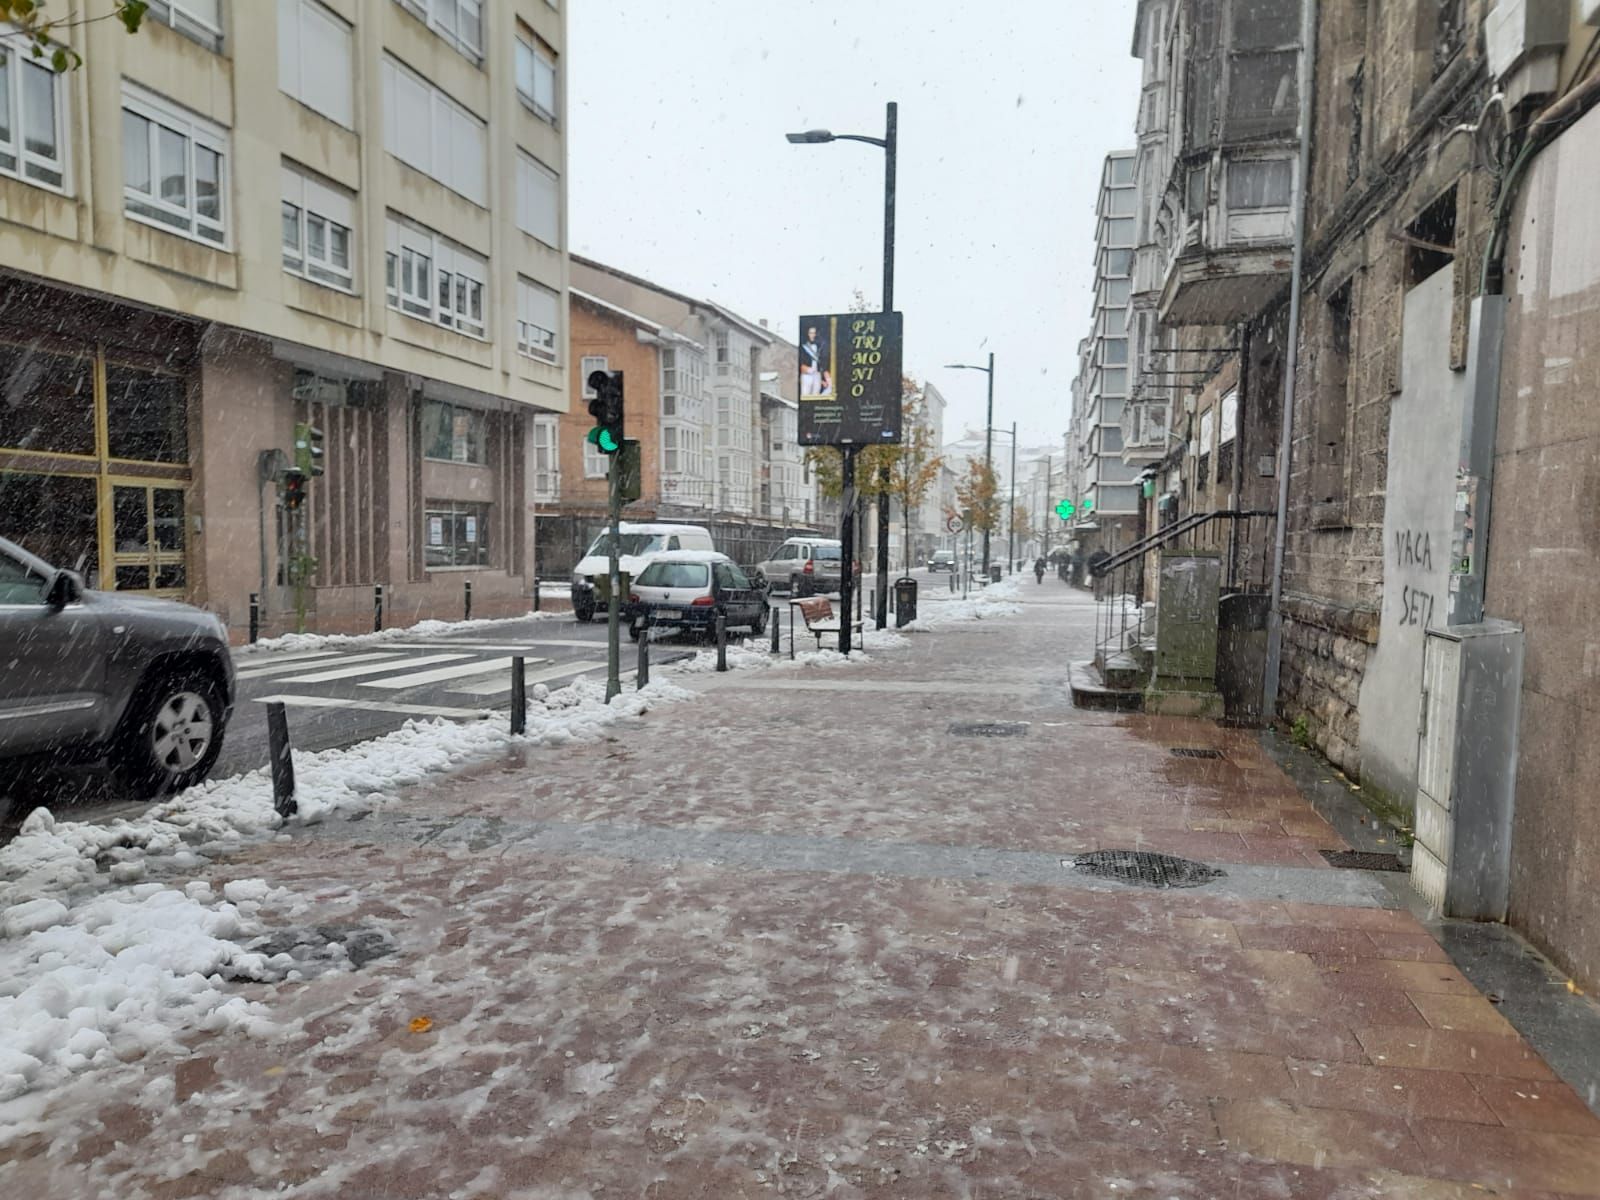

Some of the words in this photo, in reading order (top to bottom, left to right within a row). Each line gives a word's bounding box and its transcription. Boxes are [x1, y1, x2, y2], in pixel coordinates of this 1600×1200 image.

[851, 319, 876, 334] PA
[851, 351, 882, 366] MO
[851, 367, 874, 382] NI
[851, 383, 864, 397] O
